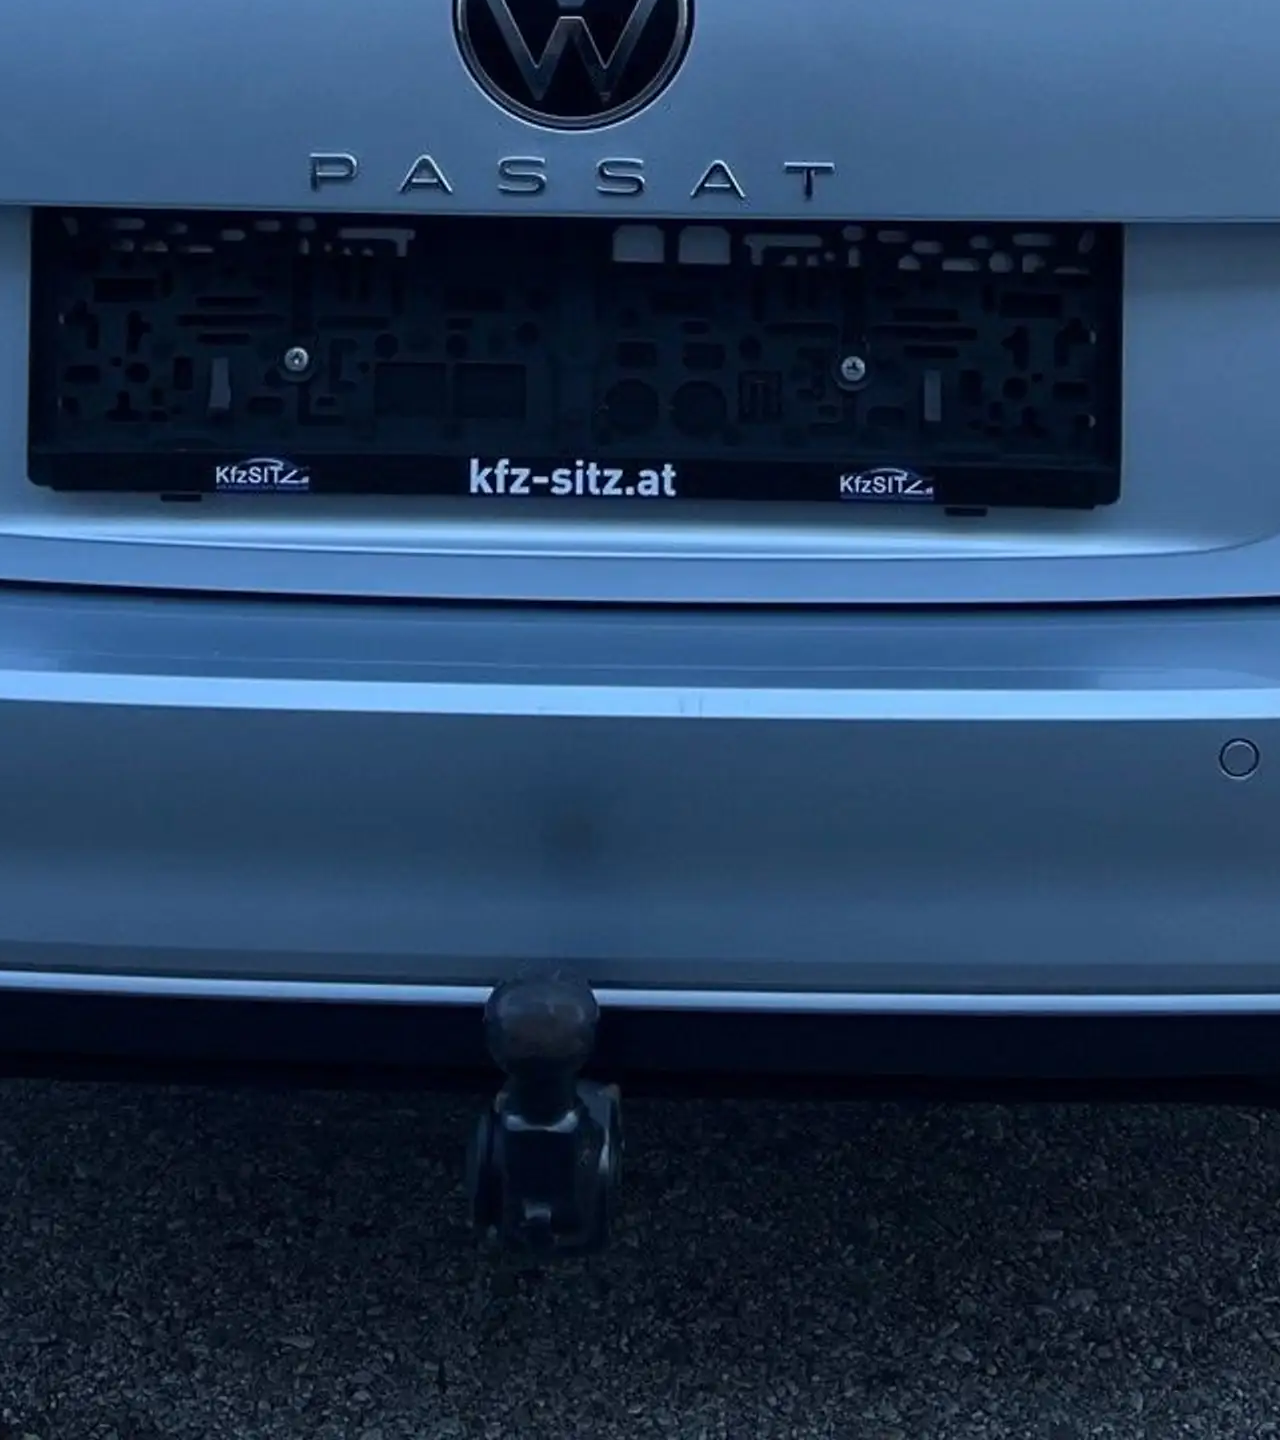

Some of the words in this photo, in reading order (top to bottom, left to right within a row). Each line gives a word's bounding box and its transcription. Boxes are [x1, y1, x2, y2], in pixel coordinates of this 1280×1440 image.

[310, 153, 836, 200] PASSAT
[215, 466, 300, 484] KfzSITZ
[469, 458, 677, 497] kfz-sitz.at
[839, 475, 925, 494] KfzSITZ
